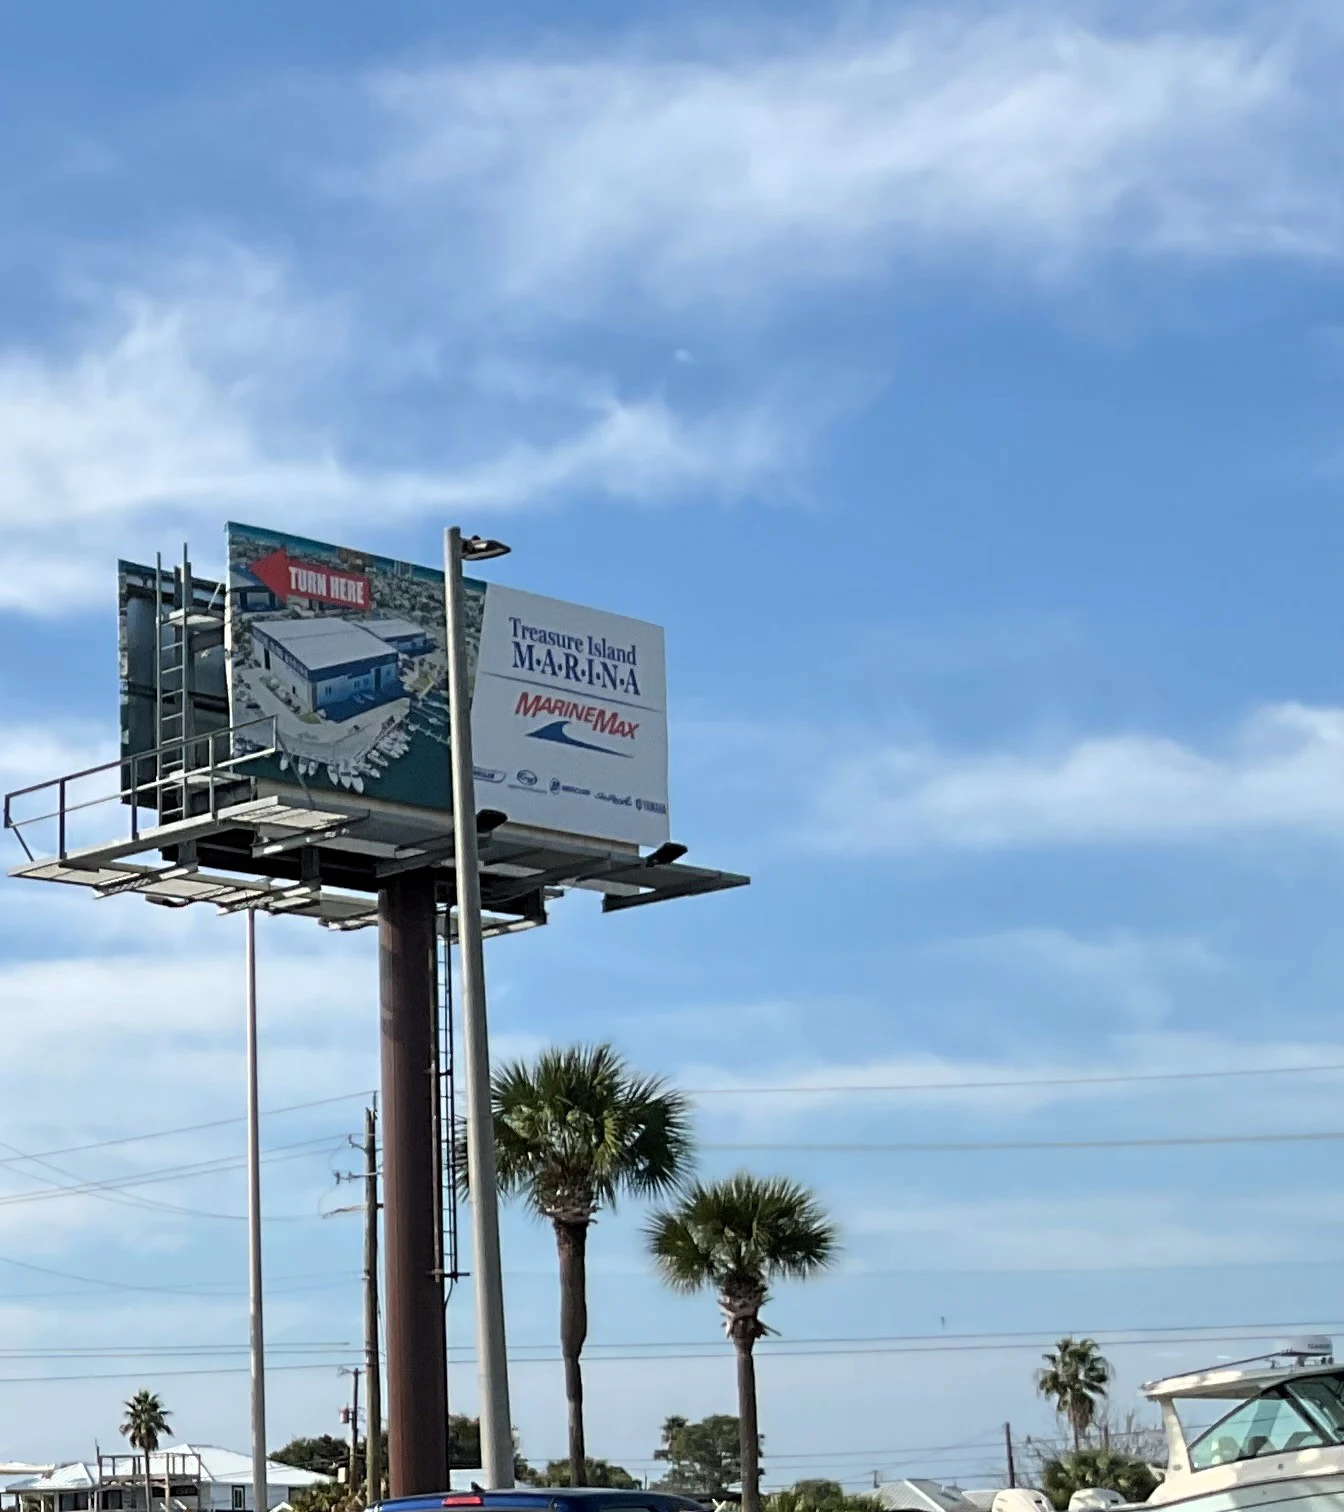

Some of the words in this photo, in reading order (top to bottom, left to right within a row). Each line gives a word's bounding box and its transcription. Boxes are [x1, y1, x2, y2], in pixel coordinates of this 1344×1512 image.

[288, 566, 327, 597] TURN
[329, 576, 364, 605] HERE
[509, 616, 584, 653] Treasure
[587, 635, 637, 666] Island
